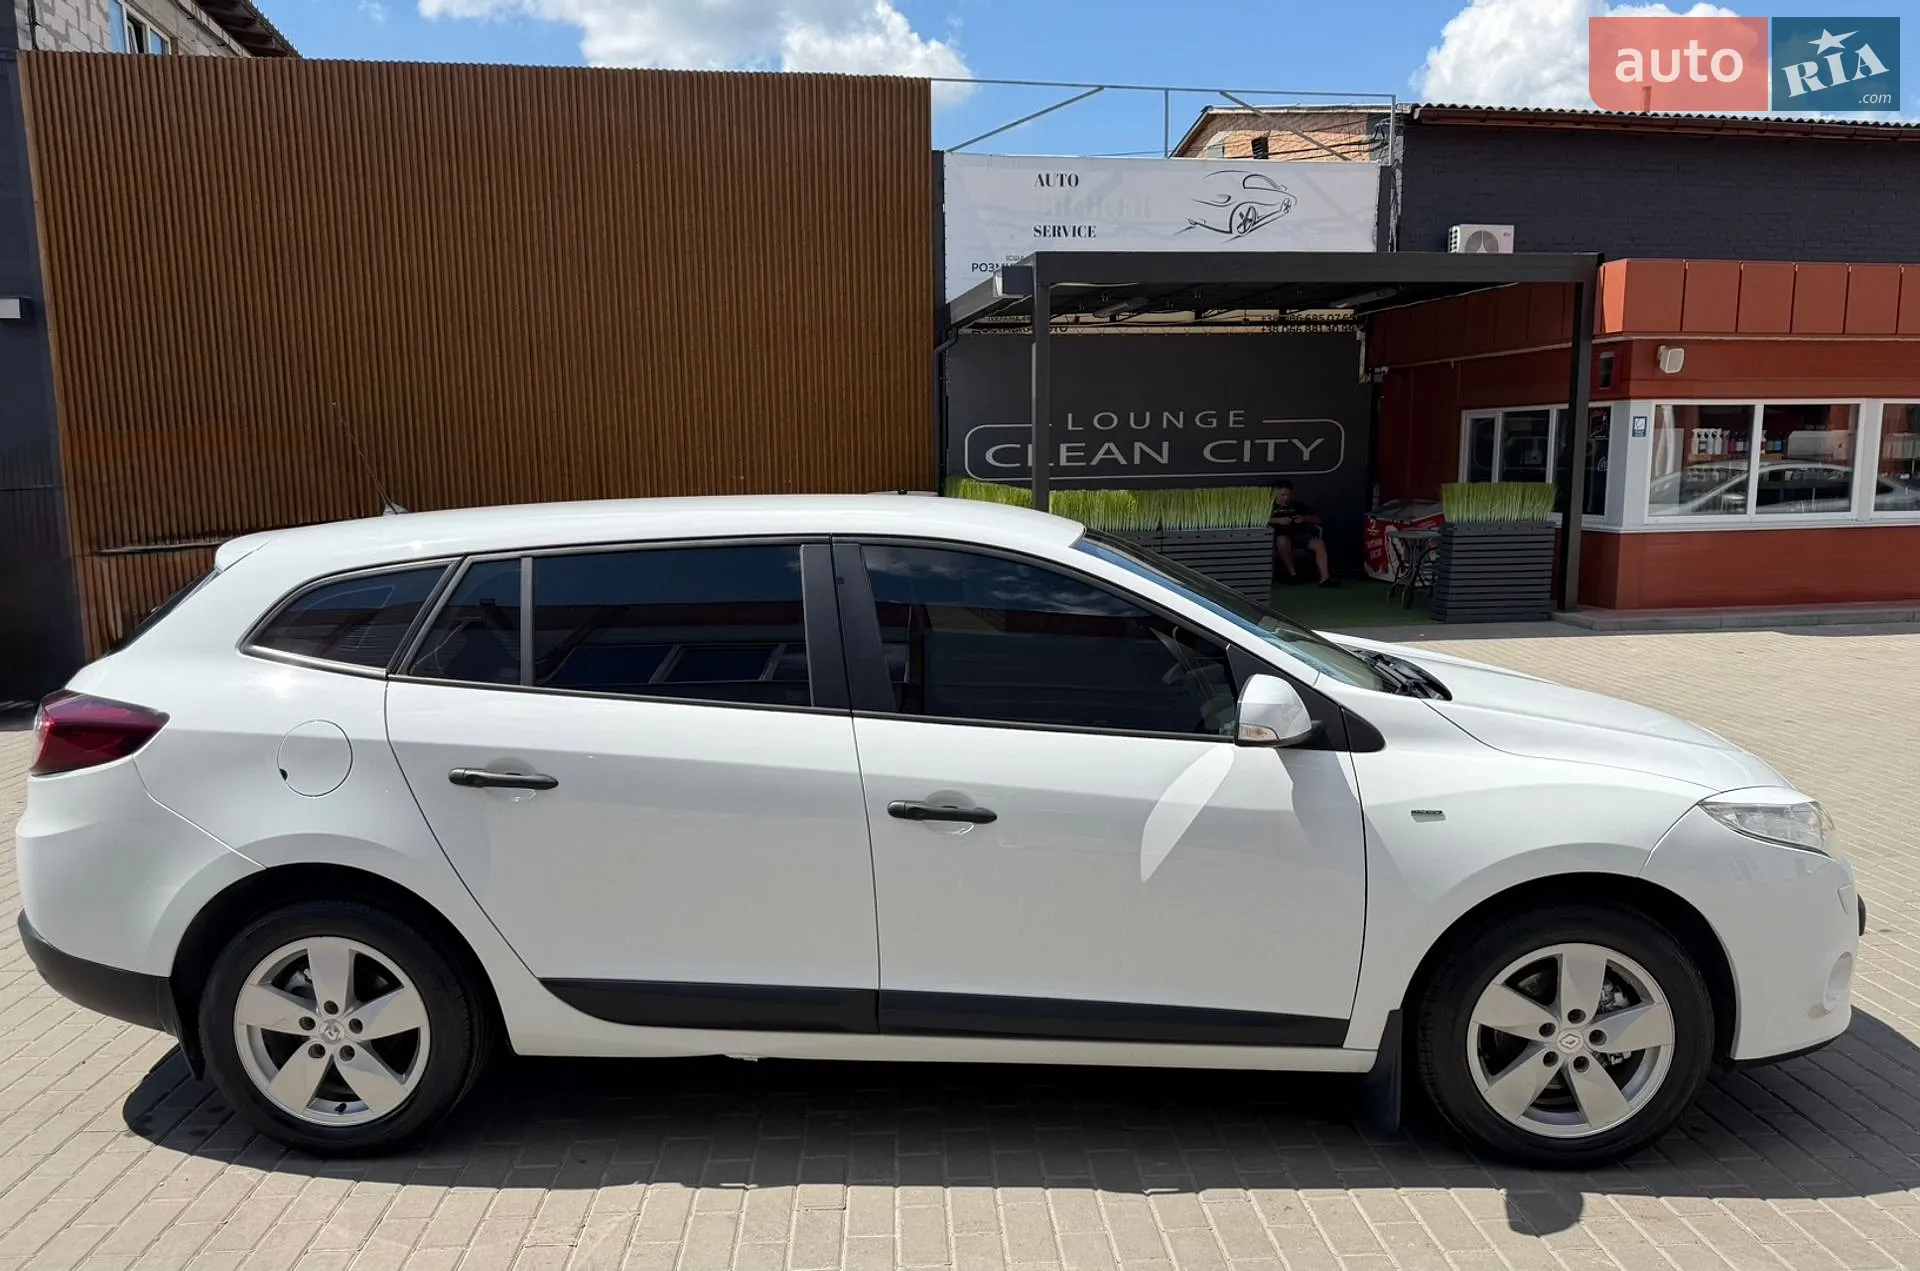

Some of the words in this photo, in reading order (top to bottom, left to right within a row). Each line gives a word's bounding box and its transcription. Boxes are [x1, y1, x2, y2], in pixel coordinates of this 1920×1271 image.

[1034, 173, 1080, 188] AUTO
[1032, 224, 1097, 239] SERVICE
[1067, 410, 1245, 431] LOUNGE
[1202, 438, 1325, 463] CITY
